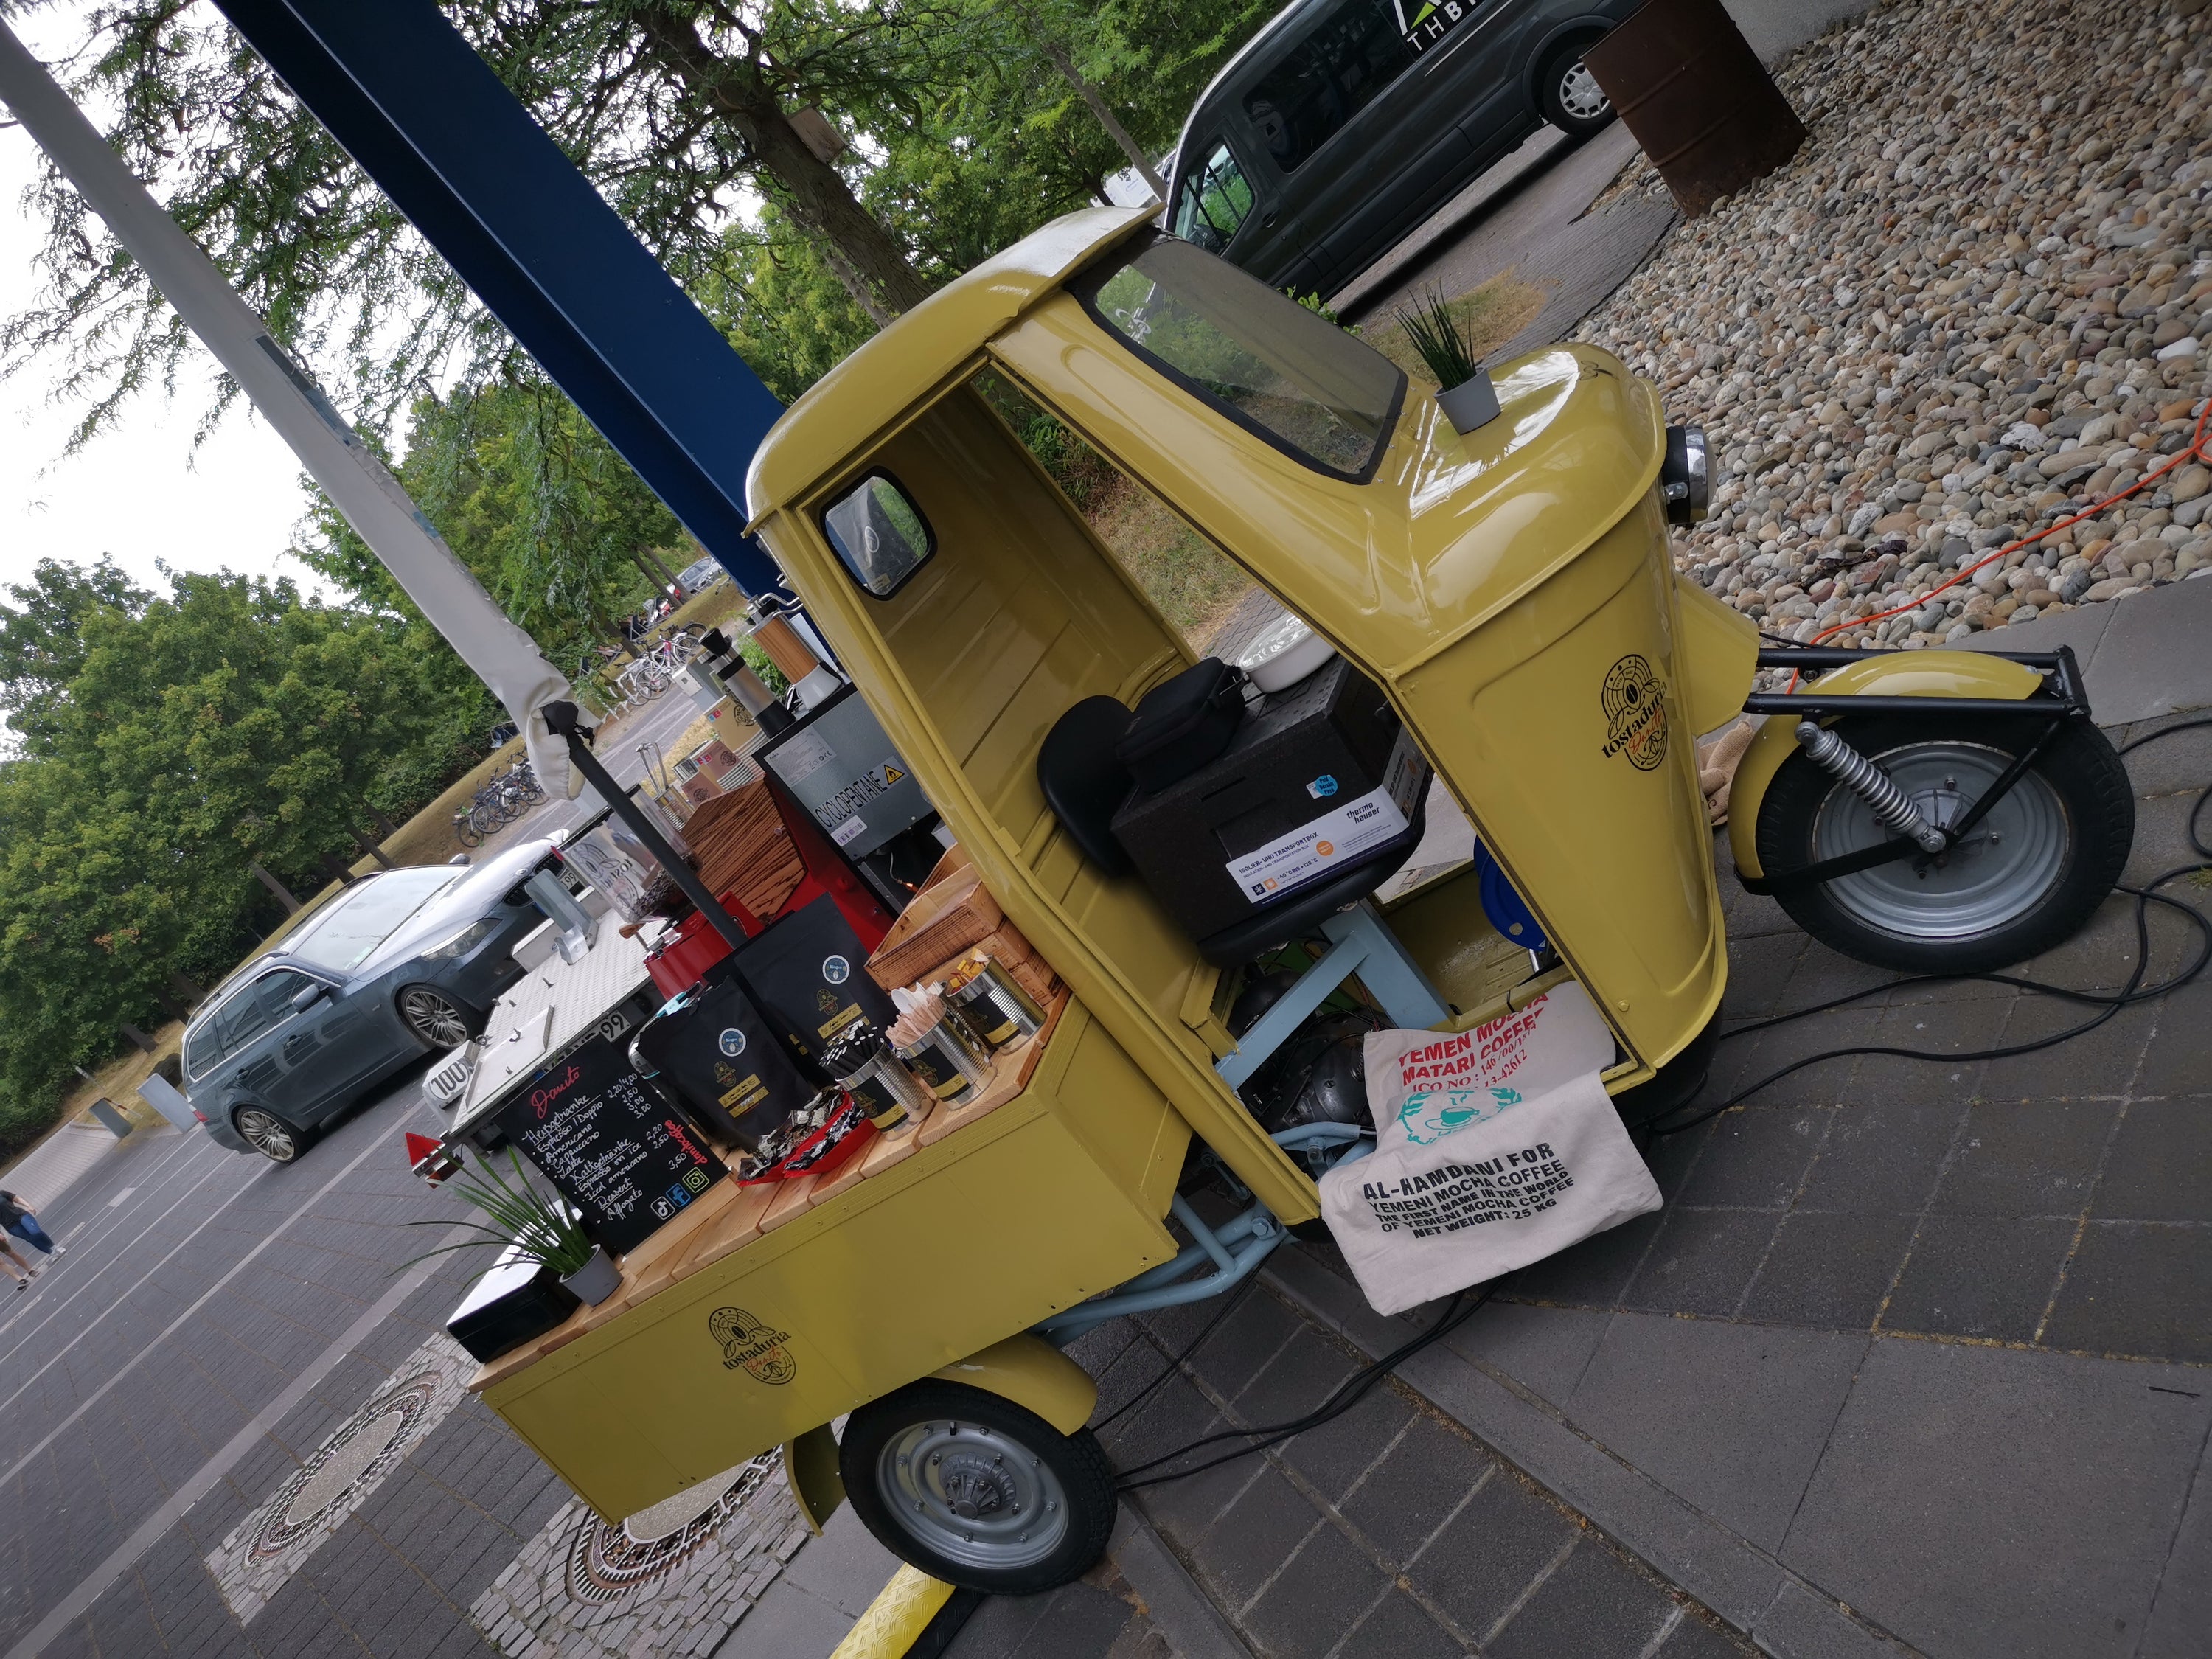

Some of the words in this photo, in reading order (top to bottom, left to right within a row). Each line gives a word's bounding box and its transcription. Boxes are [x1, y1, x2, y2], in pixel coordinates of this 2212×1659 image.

[815, 770, 888, 828] CYCLOPENTANE
[1346, 802, 1374, 819] thermo
[1354, 807, 1380, 824] hauser
[1239, 860, 1262, 874] ISOLIER-
[1262, 854, 1275, 863] UND
[1274, 832, 1319, 857] TRANSPORTBOX
[1398, 1032, 1472, 1068] YEMEN
[1477, 993, 1548, 1043] MOA
[1403, 1052, 1475, 1087] MATARI
[1447, 1077, 1472, 1090] NO
[546, 1124, 593, 1164] Americano
[622, 1087, 639, 1103] 2,50
[627, 1096, 644, 1110] 3,00
[537, 1125, 572, 1152] Espresso
[557, 1157, 585, 1179] Latte
[633, 1103, 652, 1119] 3,00
[570, 1138, 631, 1183] Kaltgetränke
[578, 1166, 611, 1192] Espresso
[613, 1155, 625, 1166] on
[628, 1142, 641, 1155] ice
[646, 1124, 663, 1141] 2,20
[585, 1181, 607, 1201] Iced
[608, 1151, 648, 1184] americano
[653, 1133, 669, 1150] 2,50
[607, 1189, 643, 1221] Affogato
[668, 1152, 686, 1170] 3,50
[1363, 1158, 1504, 1200] AL-HAMDANI
[1506, 1142, 1555, 1167] FOR
[1368, 1195, 1434, 1213] YEMENI
[1433, 1177, 1496, 1203] MOCHA
[1498, 1159, 1565, 1187] COFFEE
[594, 1178, 633, 1210] Dessert
[1375, 1214, 1401, 1222] THE
[1402, 1208, 1438, 1220] FIRST
[1440, 1192, 1479, 1212] NAME
[1480, 1189, 1496, 1197] IN
[1496, 1188, 1523, 1198] THE
[1523, 1171, 1568, 1194] WORLD
[1381, 1222, 1400, 1233] OF
[1402, 1210, 1461, 1228] YEMENI
[1461, 1199, 1517, 1214] MOCHA
[1519, 1177, 1573, 1206] COFFEE
[1412, 1226, 1441, 1239] NET
[1444, 1210, 1510, 1232] WEIGHT:
[1512, 1208, 1531, 1220] 25
[1534, 1198, 1557, 1212] KG
